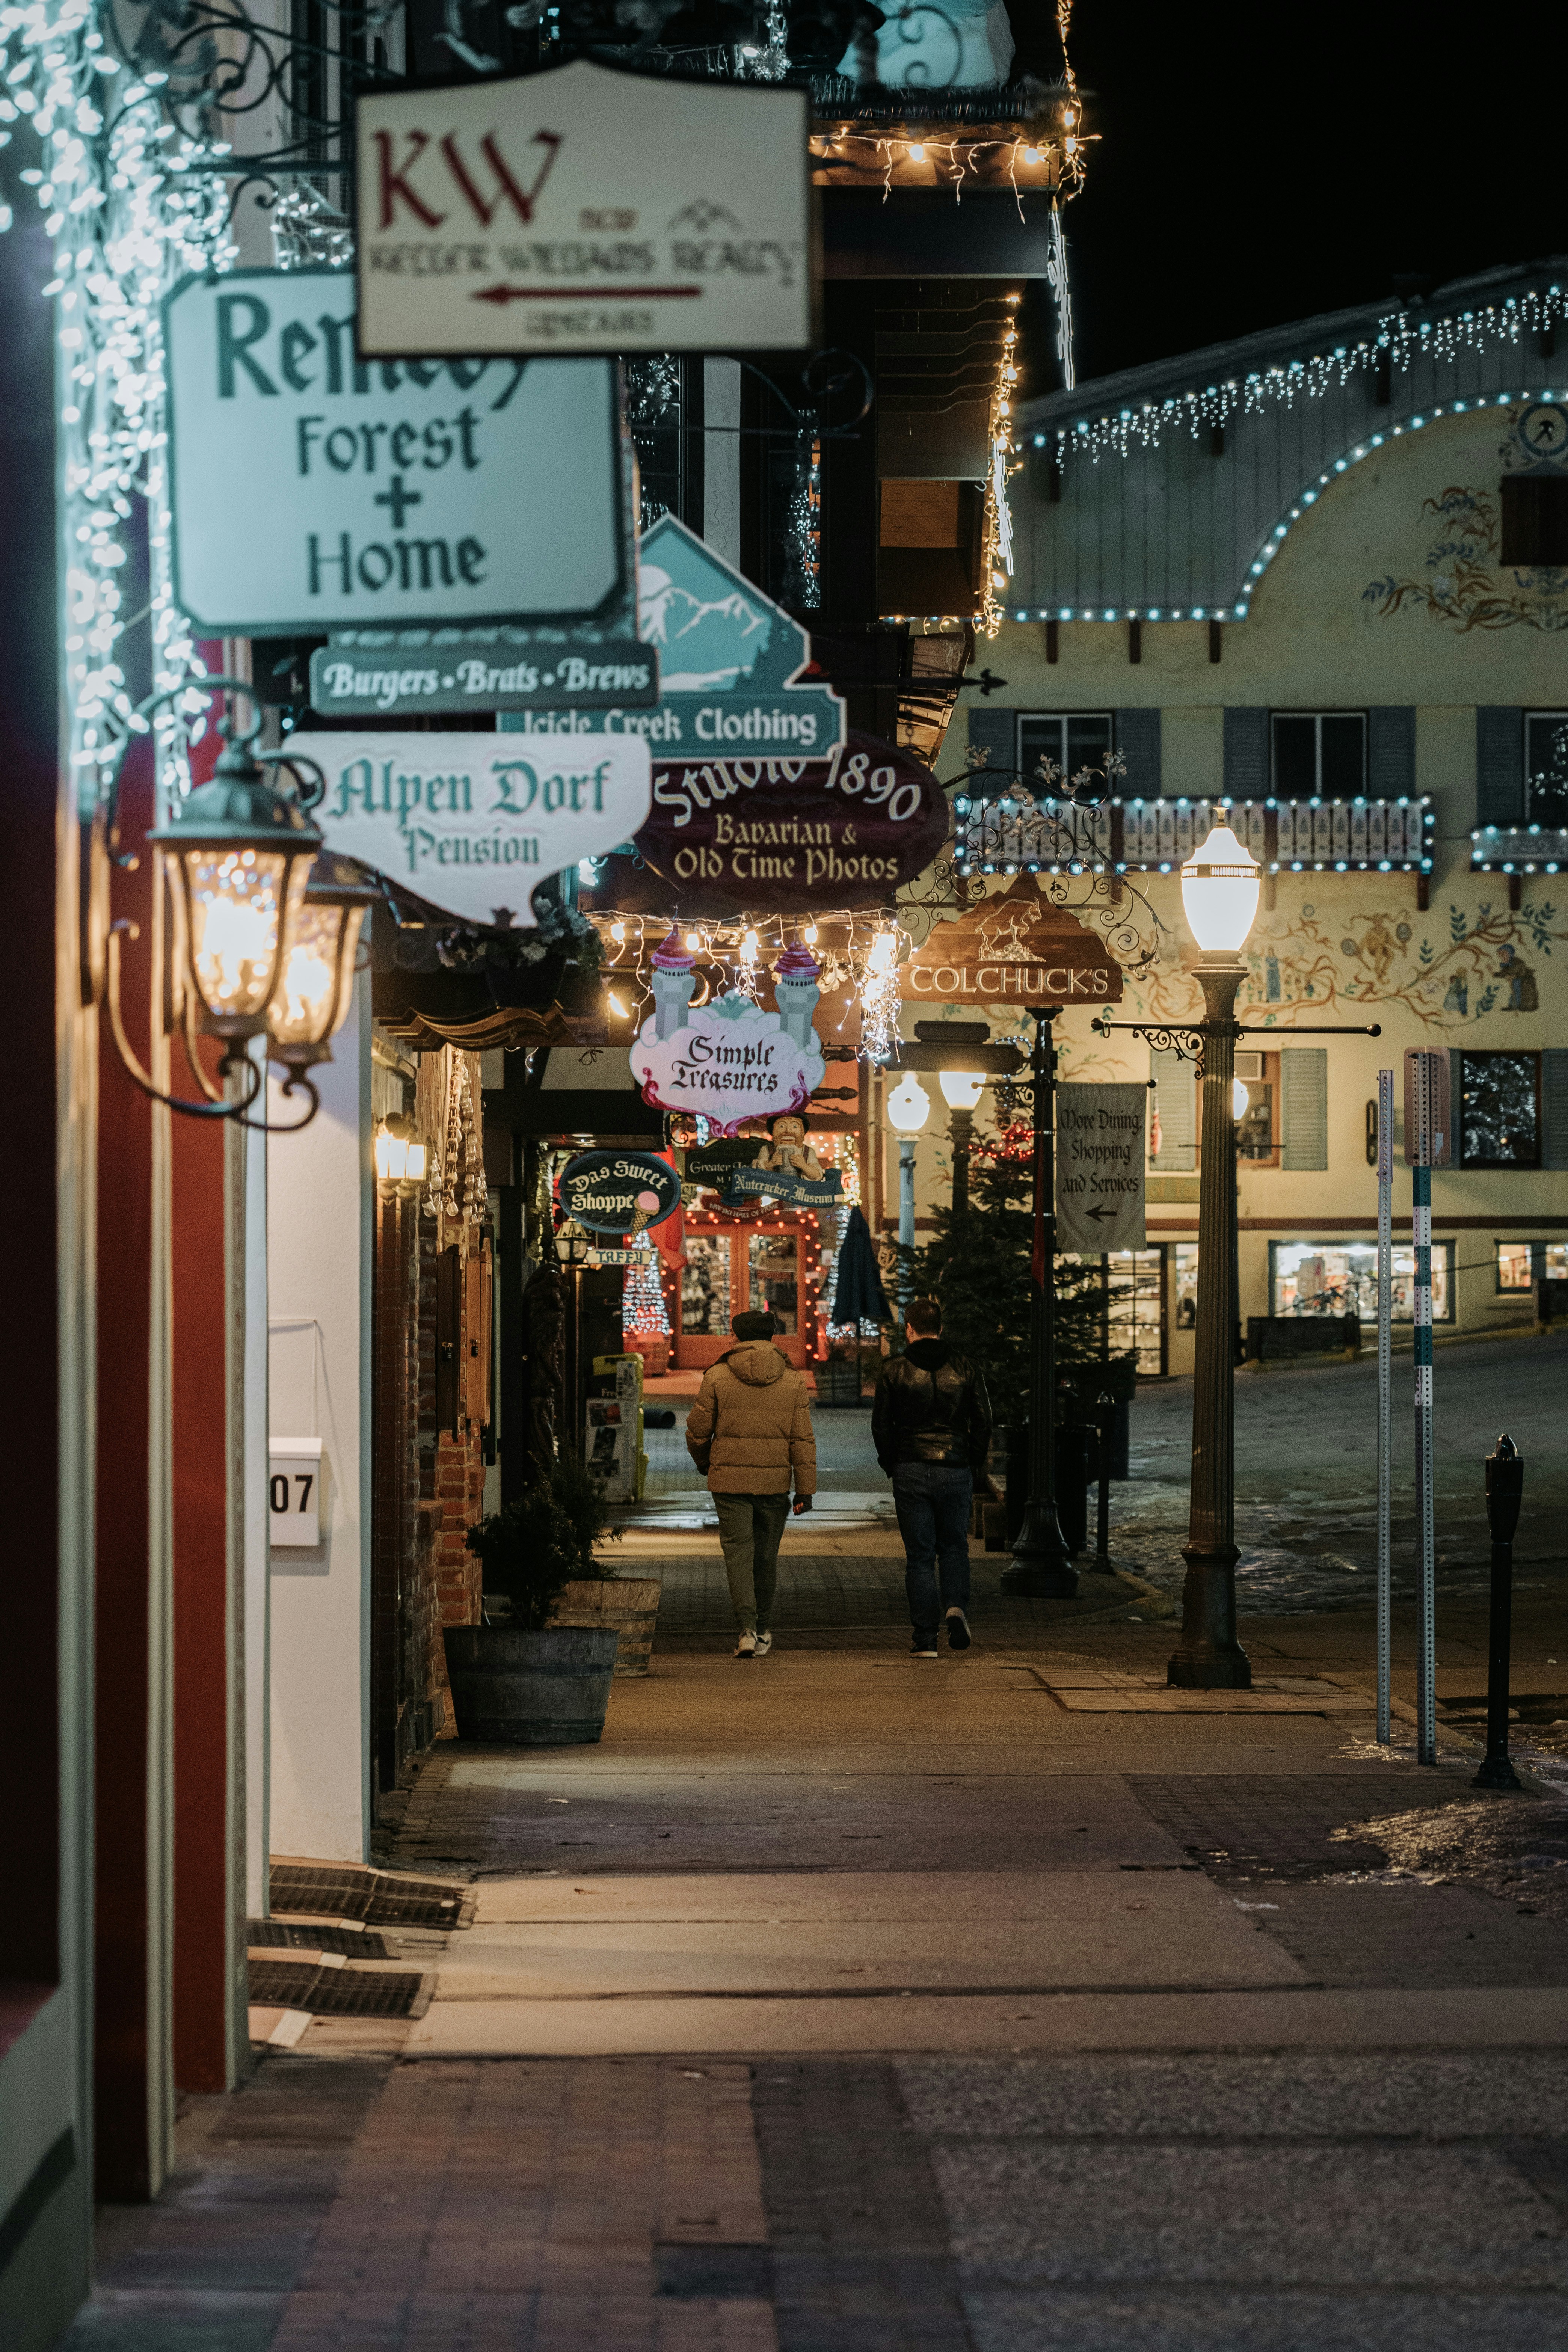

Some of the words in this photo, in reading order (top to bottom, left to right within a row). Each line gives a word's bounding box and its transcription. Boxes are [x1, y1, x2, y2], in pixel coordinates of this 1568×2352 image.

[371, 128, 564, 231] KW
[297, 407, 480, 476] Forest
[308, 532, 487, 595] Home
[323, 663, 439, 709] Burgers
[456, 660, 539, 694] Brats
[557, 657, 649, 691] Brews
[604, 708, 681, 741] Creek
[695, 708, 816, 746] Clothing
[325, 757, 472, 827] Alpen
[488, 759, 611, 813] Dorf
[824, 750, 921, 821] 1890
[715, 813, 831, 845] Bavarian
[841, 824, 857, 845] &
[399, 826, 540, 872] Pension
[675, 846, 723, 878] Old
[732, 848, 795, 878] Time
[805, 847, 898, 886] Photos
[909, 967, 1108, 994] COLCHUCK'S
[689, 1035, 774, 1071] Simple
[672, 1060, 778, 1095] Treasures
[1060, 1109, 1094, 1130] More
[690, 1161, 730, 1174] Greater
[1071, 1138, 1131, 1165] Shopping
[567, 1166, 610, 1192] Das
[613, 1160, 669, 1190] Sweet
[734, 1174, 789, 1197] Nutcracker
[789, 1185, 833, 1204] Museum
[1062, 1174, 1086, 1193] and
[1090, 1172, 1139, 1193] Services
[571, 1193, 634, 1213] Shoppe
[596, 1251, 643, 1264] TAFFY
[270, 1474, 313, 1513] 07
